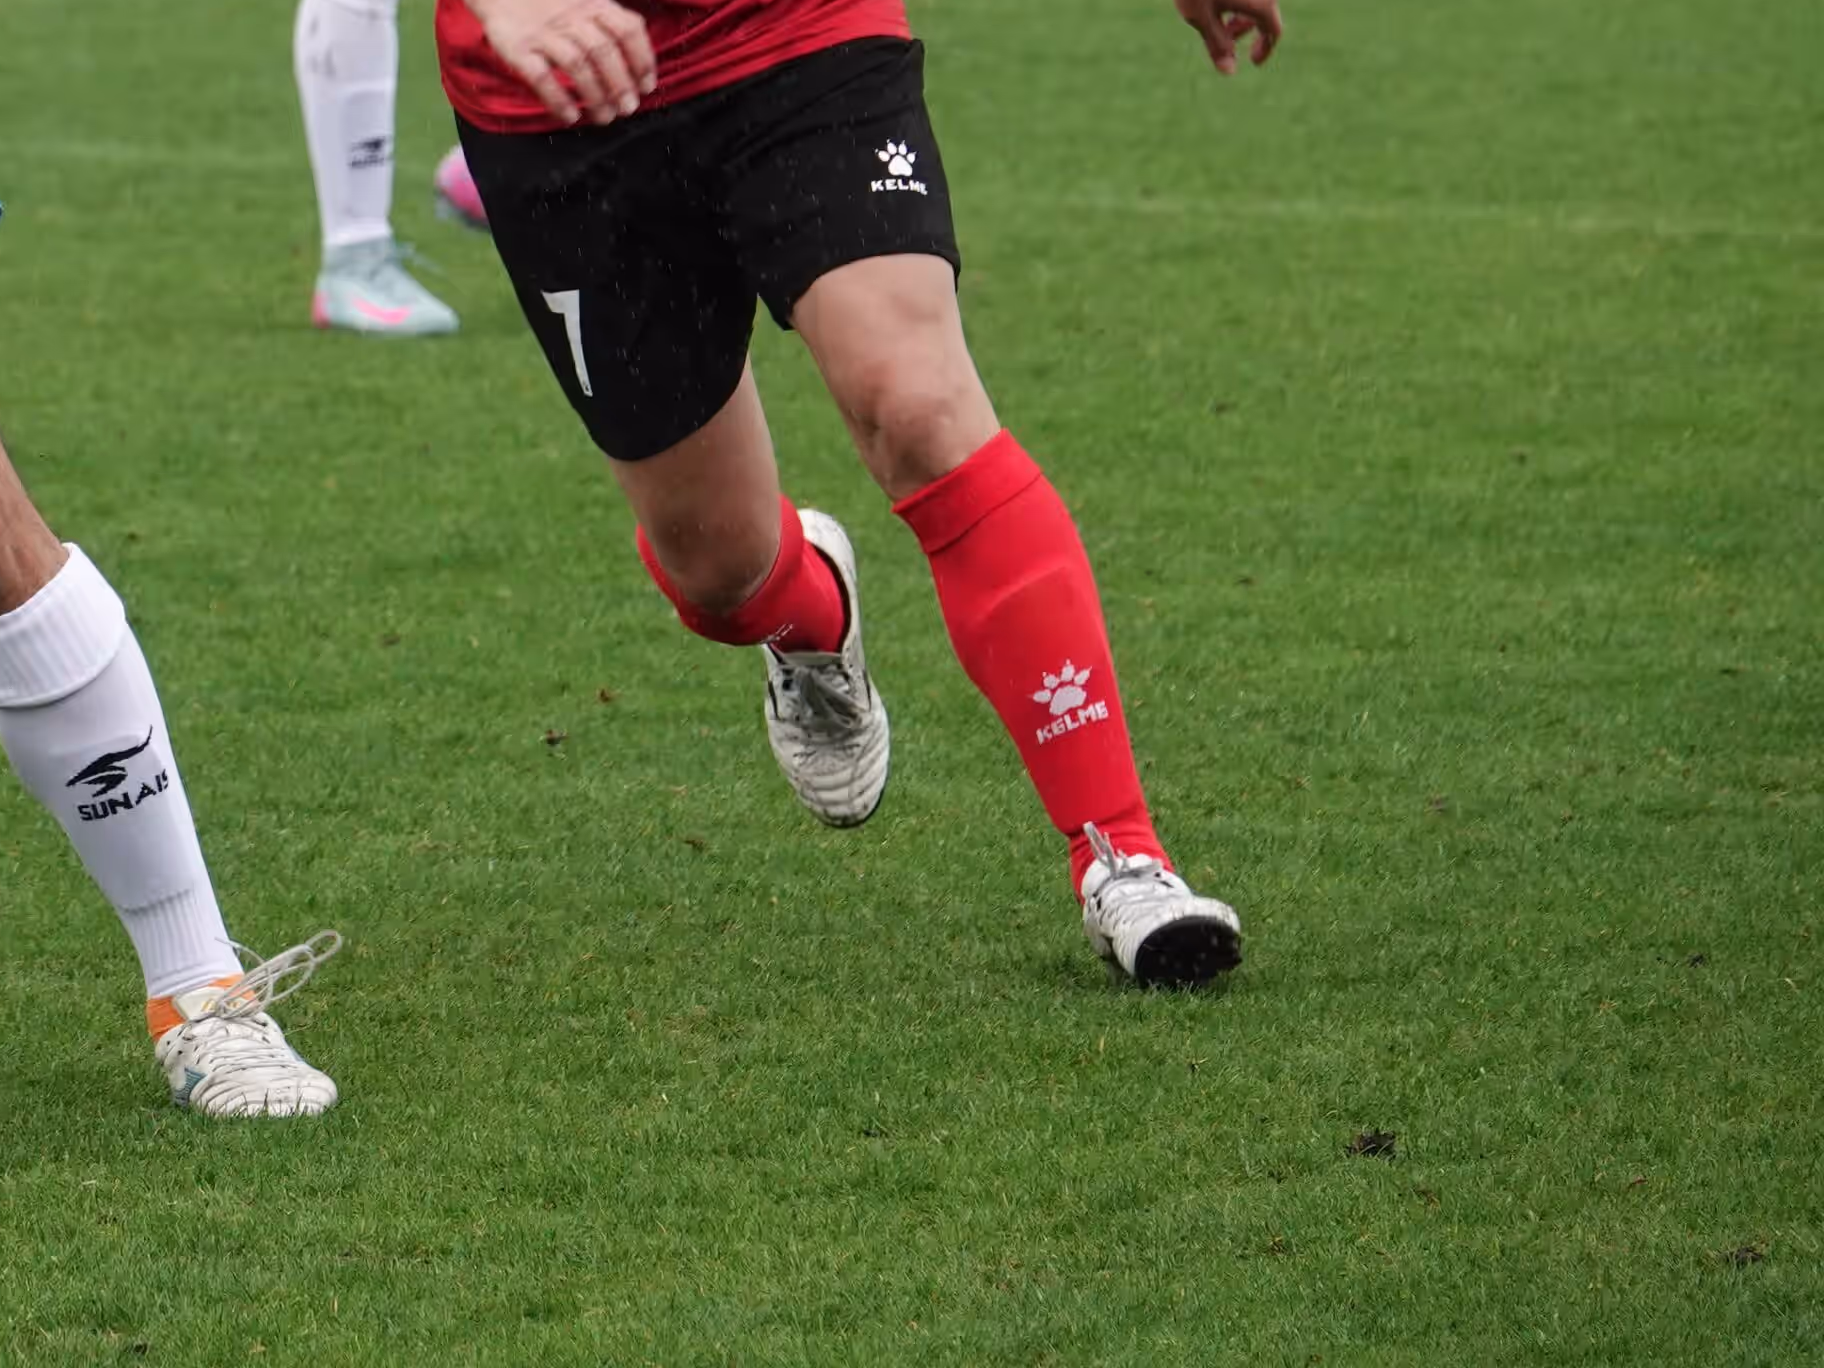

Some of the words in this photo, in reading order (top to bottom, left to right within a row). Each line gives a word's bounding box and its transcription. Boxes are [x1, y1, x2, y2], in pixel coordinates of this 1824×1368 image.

[871, 178, 928, 196] KELME
[539, 288, 594, 398] 7
[1035, 700, 1110, 745] KELME
[77, 768, 169, 822] SUNAIS
